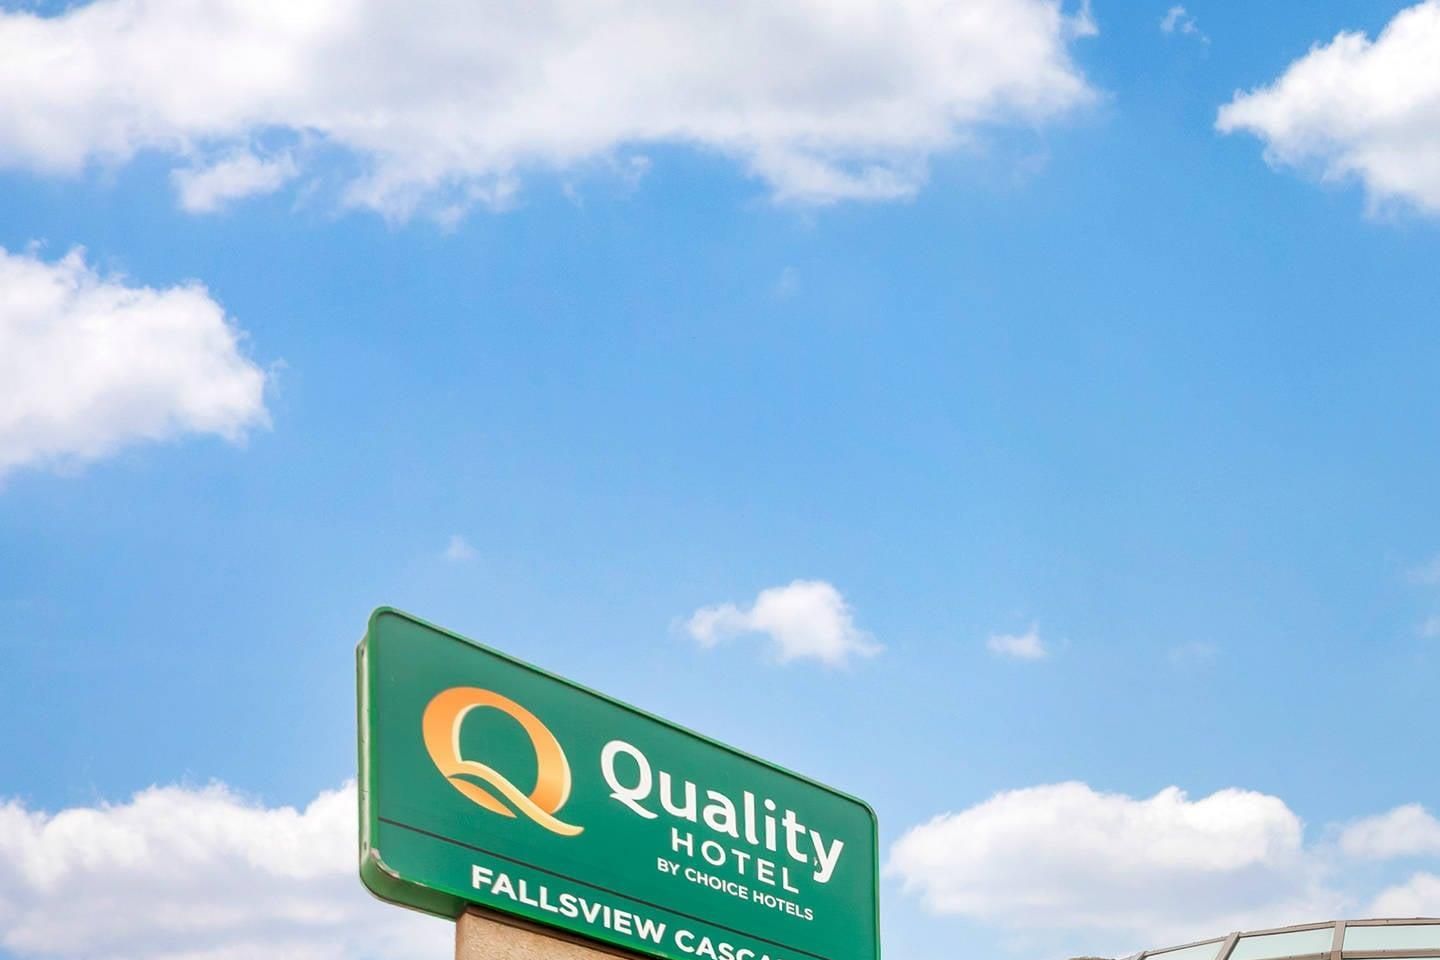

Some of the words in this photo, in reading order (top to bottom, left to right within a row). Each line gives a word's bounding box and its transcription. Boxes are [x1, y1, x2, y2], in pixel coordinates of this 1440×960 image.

[600, 739, 845, 883] Quality
[656, 858, 681, 878] BY
[684, 866, 749, 900] CHOICE
[753, 888, 814, 921] HOTELS
[671, 828, 800, 894] HOTEL
[471, 864, 667, 943] FALLSVIEW
